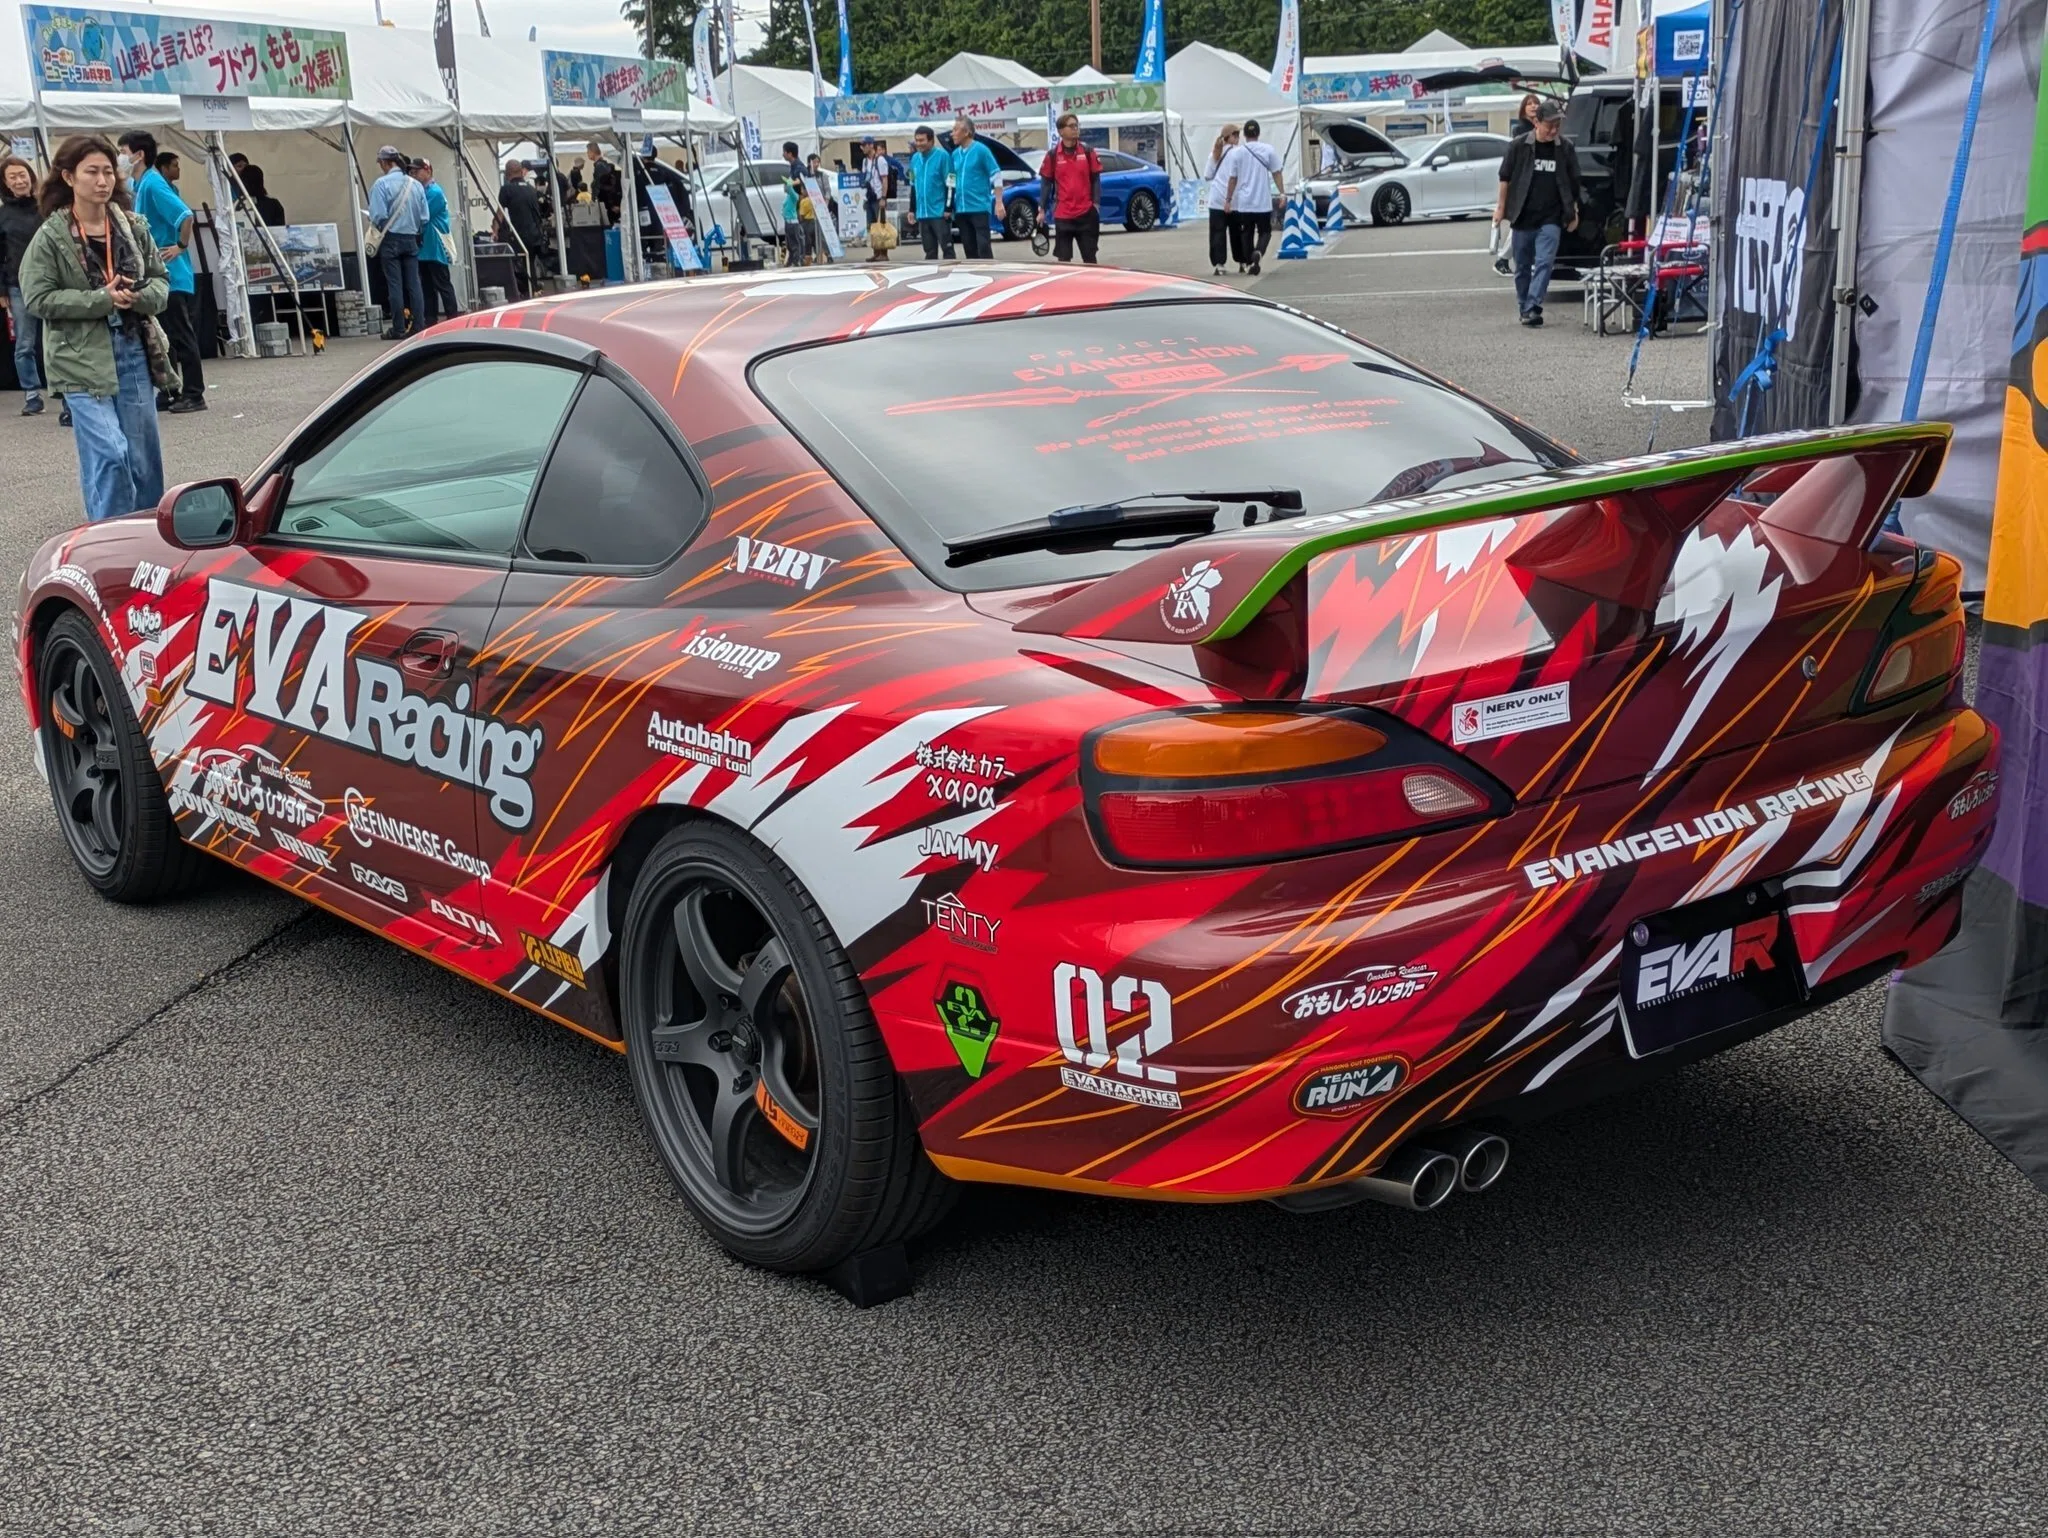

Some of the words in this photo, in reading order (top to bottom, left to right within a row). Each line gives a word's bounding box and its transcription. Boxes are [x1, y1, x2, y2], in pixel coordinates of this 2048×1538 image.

[1013, 344, 1259, 382] EVANGELION
[1029, 336, 1201, 361] PROJECT
[1115, 365, 1217, 386] RACING
[723, 535, 840, 591] NERV
[186, 577, 370, 742] EVA
[351, 656, 543, 829] Racing
[1486, 698, 1525, 714] NERV
[1528, 690, 1564, 706] ONLY
[647, 711, 752, 760] Autobahn
[647, 733, 722, 772] Professional
[725, 757, 752, 778] tool
[271, 827, 337, 873] BRIDE
[352, 802, 441, 858] REFINVERSE
[443, 839, 492, 886] Group
[918, 827, 999, 872] JAMMY
[1523, 803, 1757, 889] EVANGELION
[1756, 766, 1873, 820] RACING
[350, 863, 409, 903] RAYS
[920, 896, 1001, 943] TENTY
[1636, 914, 1780, 1005] EVAR
[946, 1000, 987, 1021] EVA
[1294, 980, 1425, 1019] おもしろレンタカー
[1053, 961, 1179, 1084] 02
[1063, 1069, 1098, 1089] EVA
[1099, 1079, 1178, 1104] RACING
[1322, 1068, 1368, 1085] TEAM
